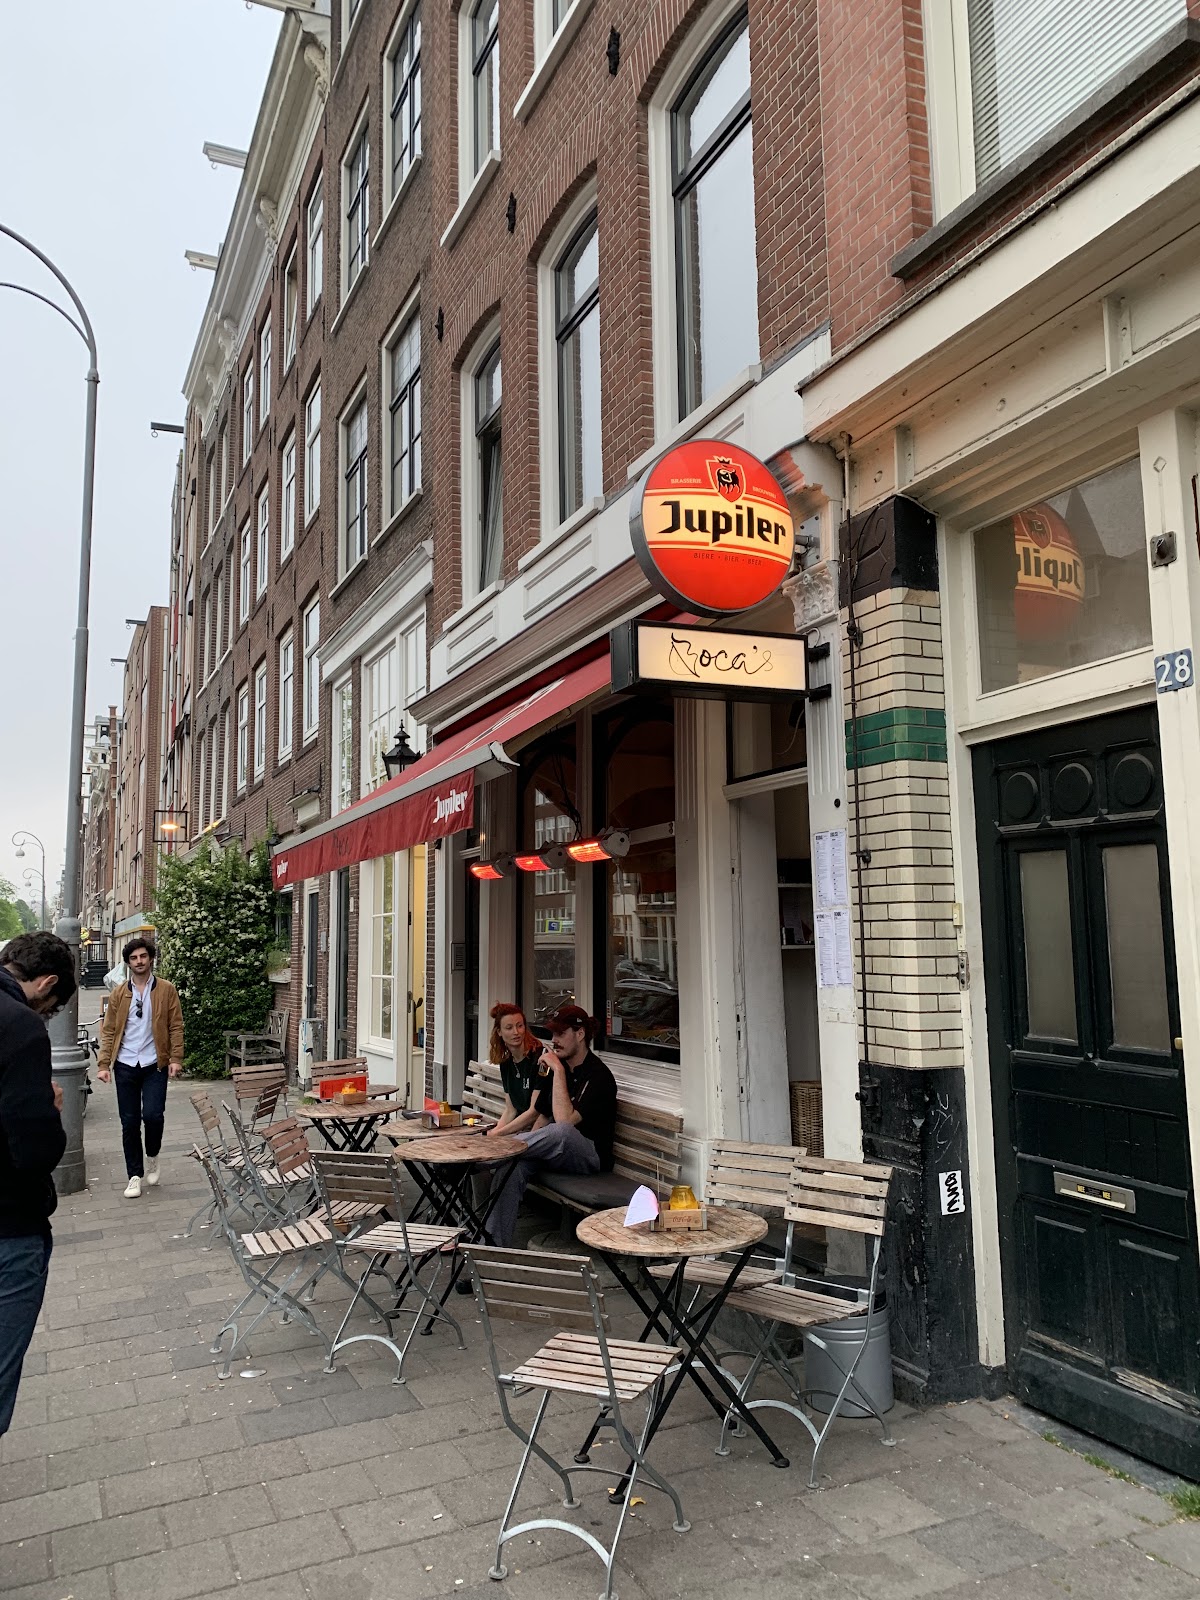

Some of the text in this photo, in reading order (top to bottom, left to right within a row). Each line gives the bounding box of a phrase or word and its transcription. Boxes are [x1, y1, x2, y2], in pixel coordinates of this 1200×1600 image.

[657, 500, 786, 545] Jupiler
[724, 554, 739, 562] BIER
[747, 558, 762, 566] BEER
[669, 632, 773, 678] Roca's
[1156, 654, 1191, 688] 28
[432, 789, 468, 824] Jupiler
